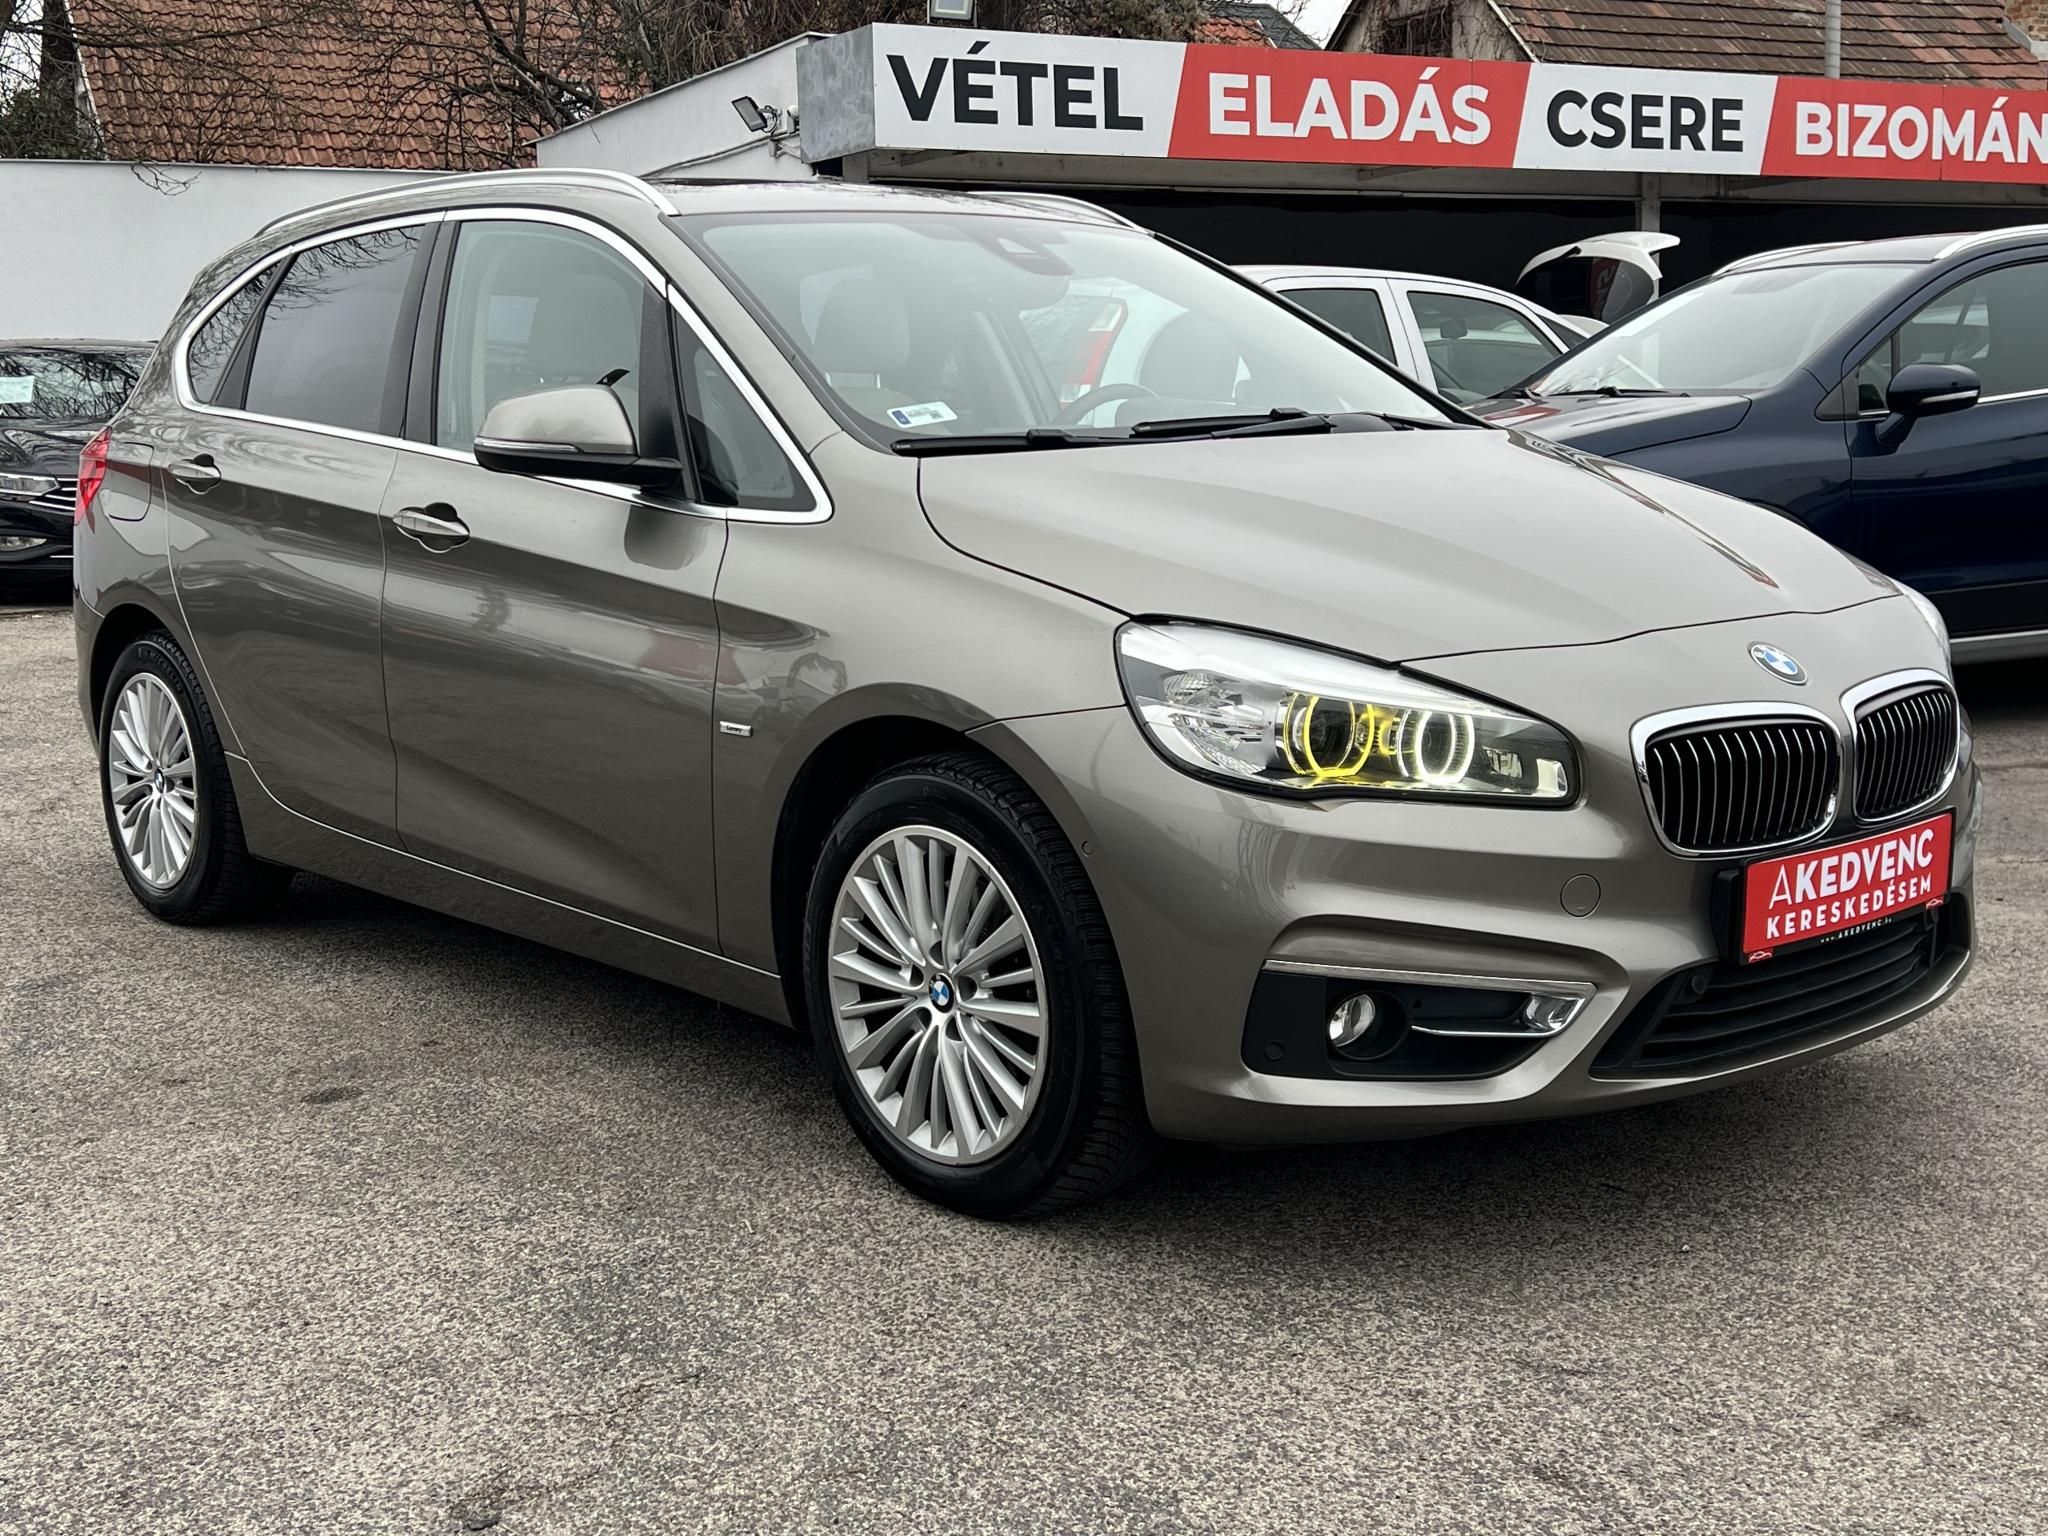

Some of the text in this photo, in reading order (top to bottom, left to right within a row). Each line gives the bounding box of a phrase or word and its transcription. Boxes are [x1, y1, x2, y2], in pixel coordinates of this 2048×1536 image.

[886, 40, 2048, 164] VÉTEL ELADÁS CSERE BIZOMÁN
[1766, 872, 1932, 939] KERESKEDÉSEM
